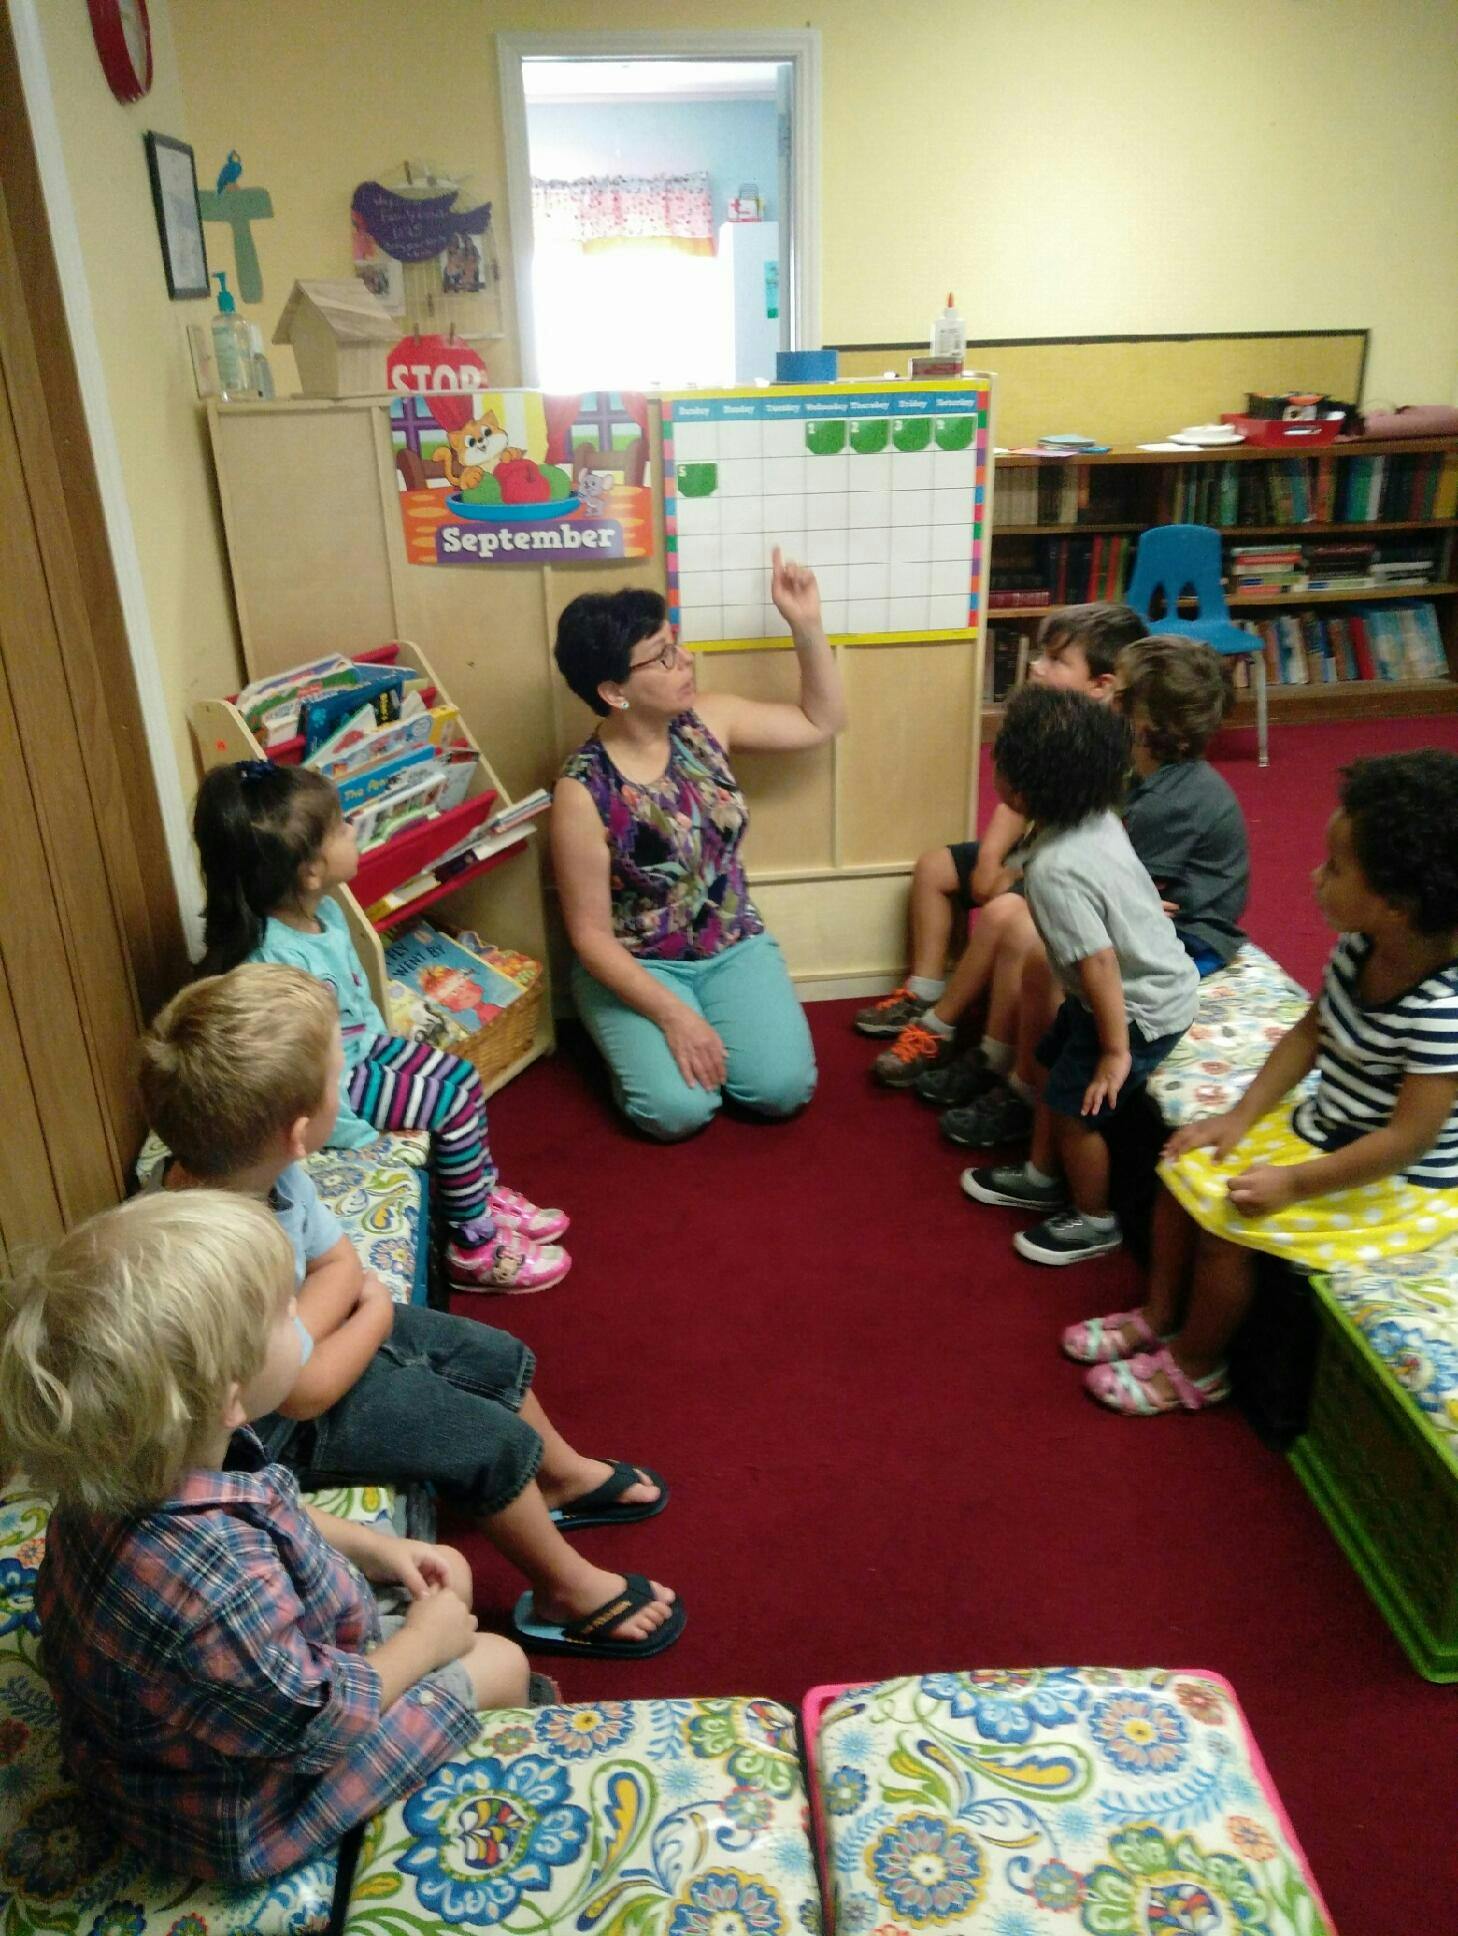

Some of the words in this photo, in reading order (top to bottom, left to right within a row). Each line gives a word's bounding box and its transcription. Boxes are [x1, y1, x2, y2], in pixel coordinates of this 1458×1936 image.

[391, 364, 481, 391] STOP
[442, 523, 616, 558] September
[392, 951, 426, 976] WENT
